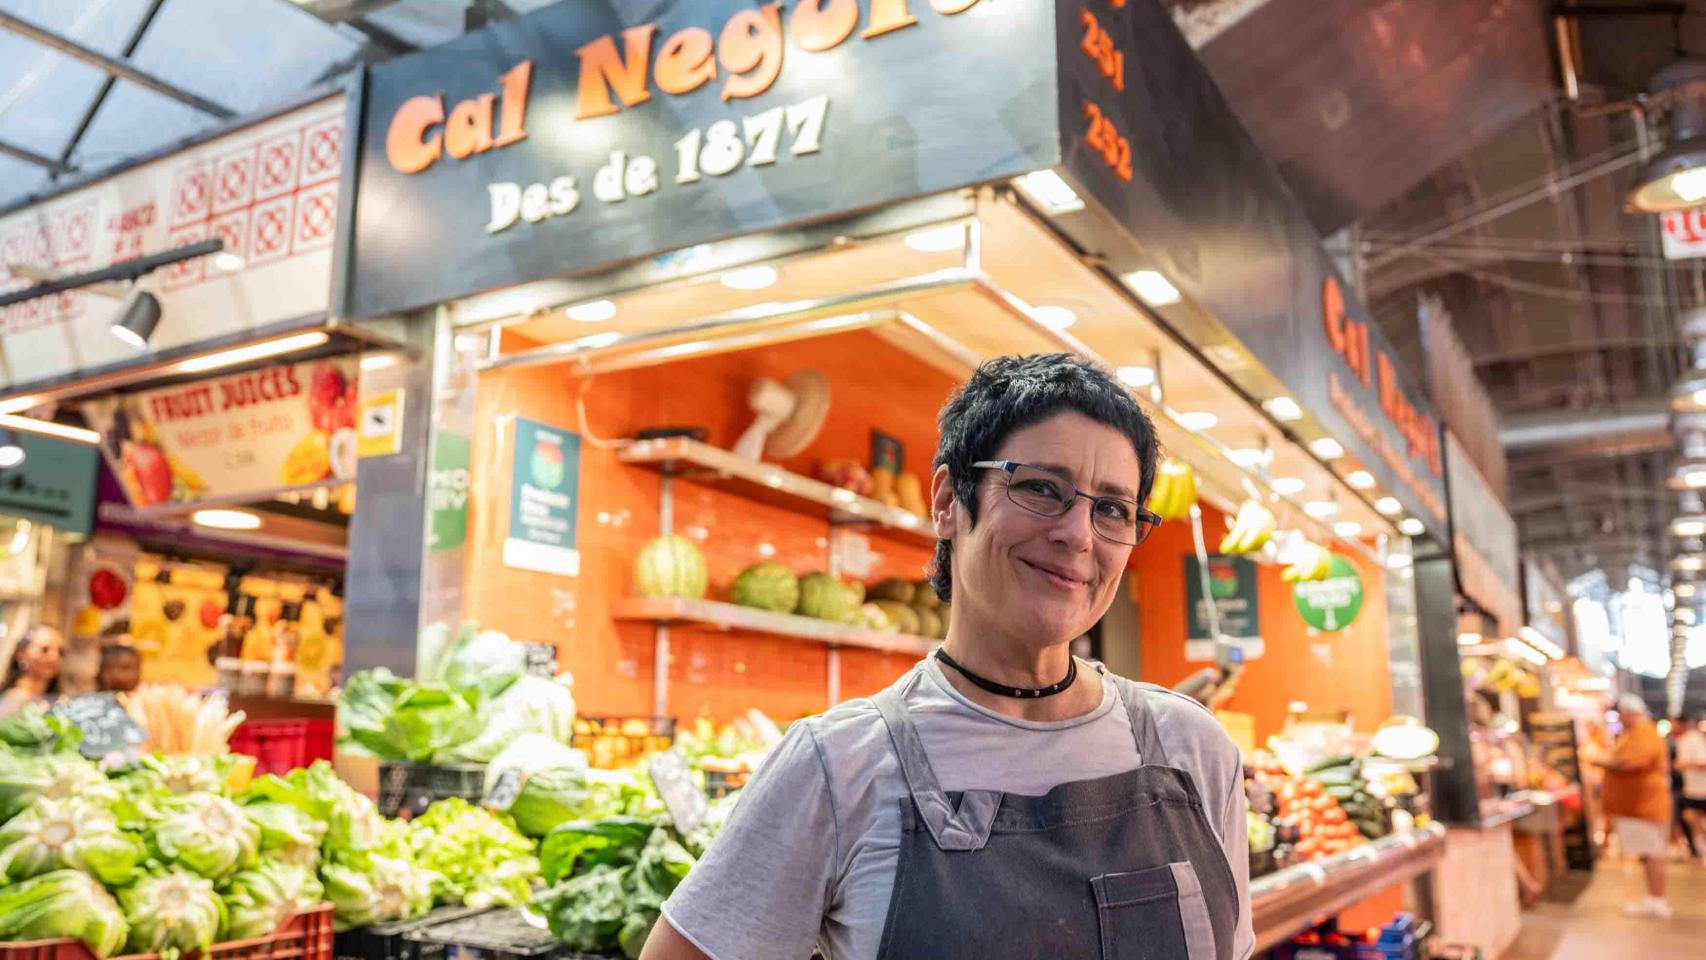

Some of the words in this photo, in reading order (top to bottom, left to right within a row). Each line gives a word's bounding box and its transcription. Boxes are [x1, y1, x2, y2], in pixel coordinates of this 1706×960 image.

[386, 61, 531, 174] Cal
[573, 0, 990, 121] Negor
[486, 174, 580, 234] Des
[593, 150, 659, 203] de
[673, 95, 830, 185] 1877
[151, 386, 214, 422] FRUIT
[219, 364, 301, 411] JUICES
